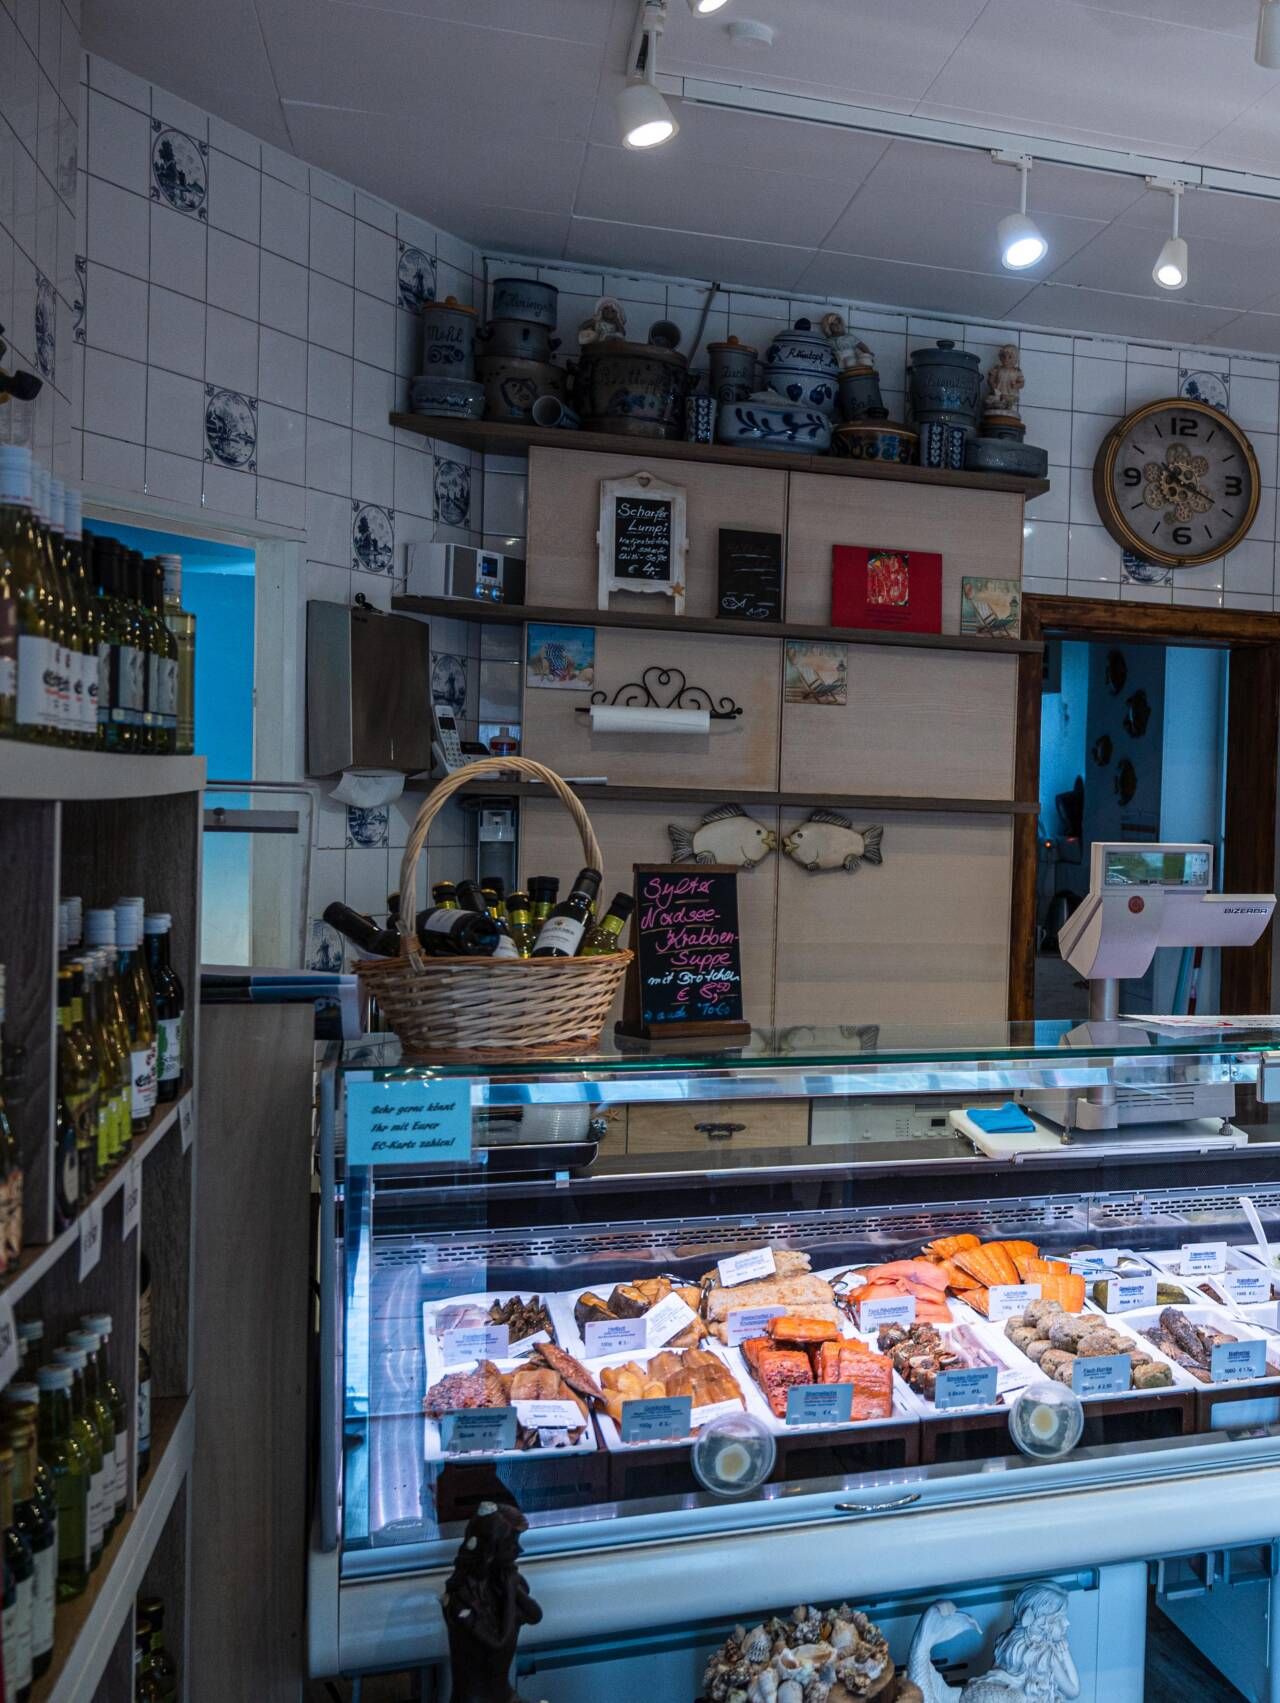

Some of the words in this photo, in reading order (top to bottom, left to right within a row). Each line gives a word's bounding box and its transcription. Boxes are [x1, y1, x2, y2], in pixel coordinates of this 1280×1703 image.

[1171, 417, 1199, 437] 12
[1123, 467, 1142, 487] 9
[1225, 475, 1243, 497] 3
[1172, 527, 1193, 545] 6
[643, 878, 716, 909] Sylter
[671, 950, 733, 973] Suppe
[648, 971, 675, 986] mit
[676, 968, 740, 985] Brötchen
[371, 1105, 395, 1115] Sehr
[396, 1105, 425, 1116] gerne
[426, 1102, 456, 1112] könnt
[390, 1122, 409, 1132] mit
[411, 1121, 441, 1131] Eurer
[371, 1141, 417, 1152] EC-Karte
